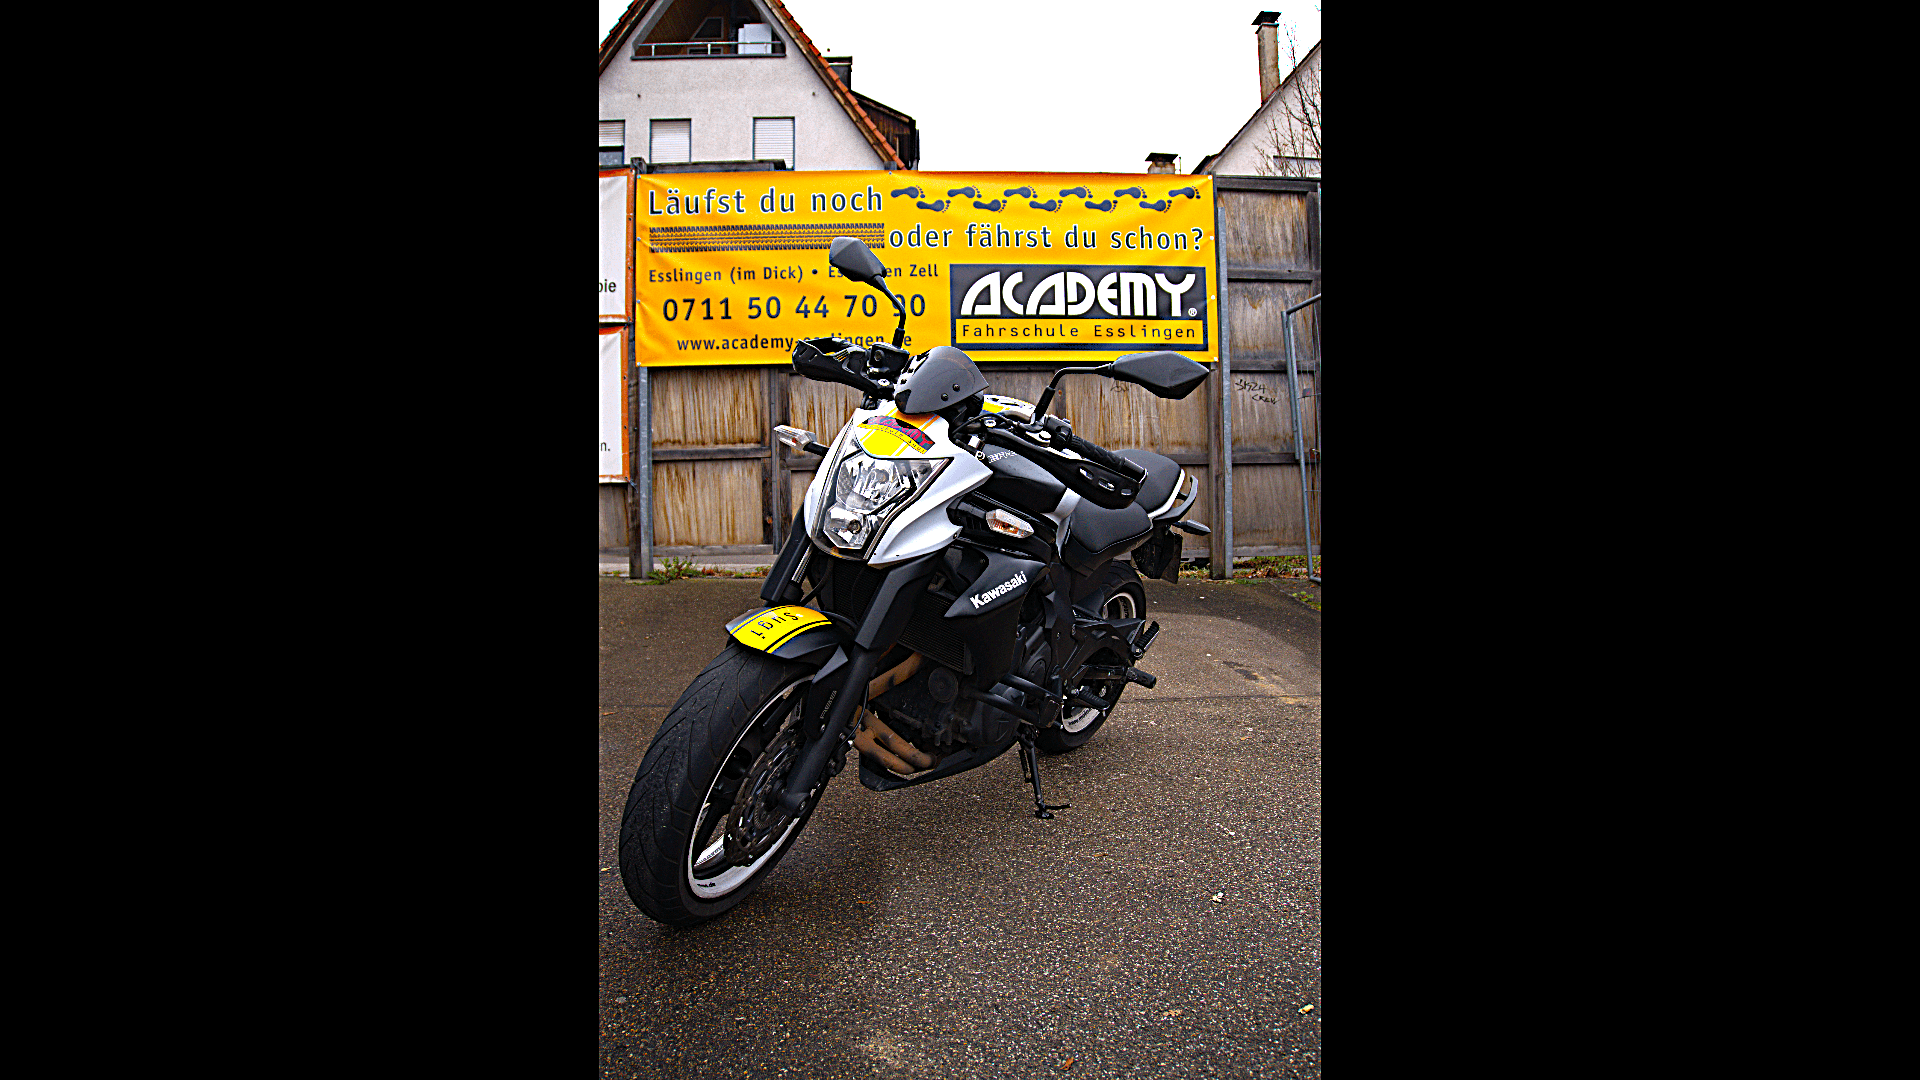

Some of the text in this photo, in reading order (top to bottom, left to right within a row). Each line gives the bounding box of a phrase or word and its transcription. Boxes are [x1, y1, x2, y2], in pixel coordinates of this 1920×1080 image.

[649, 185, 883, 215] Läufst du noch
[889, 223, 1204, 250] oder fährst du schon?
[649, 267, 722, 285] Esslingen
[730, 266, 756, 284] (im
[763, 265, 803, 283] Dick)
[909, 263, 938, 277] Zell
[663, 297, 732, 321] 0711
[748, 296, 781, 319] 50
[795, 295, 829, 318] 44
[844, 294, 877, 318] 70
[960, 271, 1196, 317] ACADEMY
[962, 324, 1195, 340] Fahrschule Esslingen
[969, 570, 1028, 609] Kawasaki
